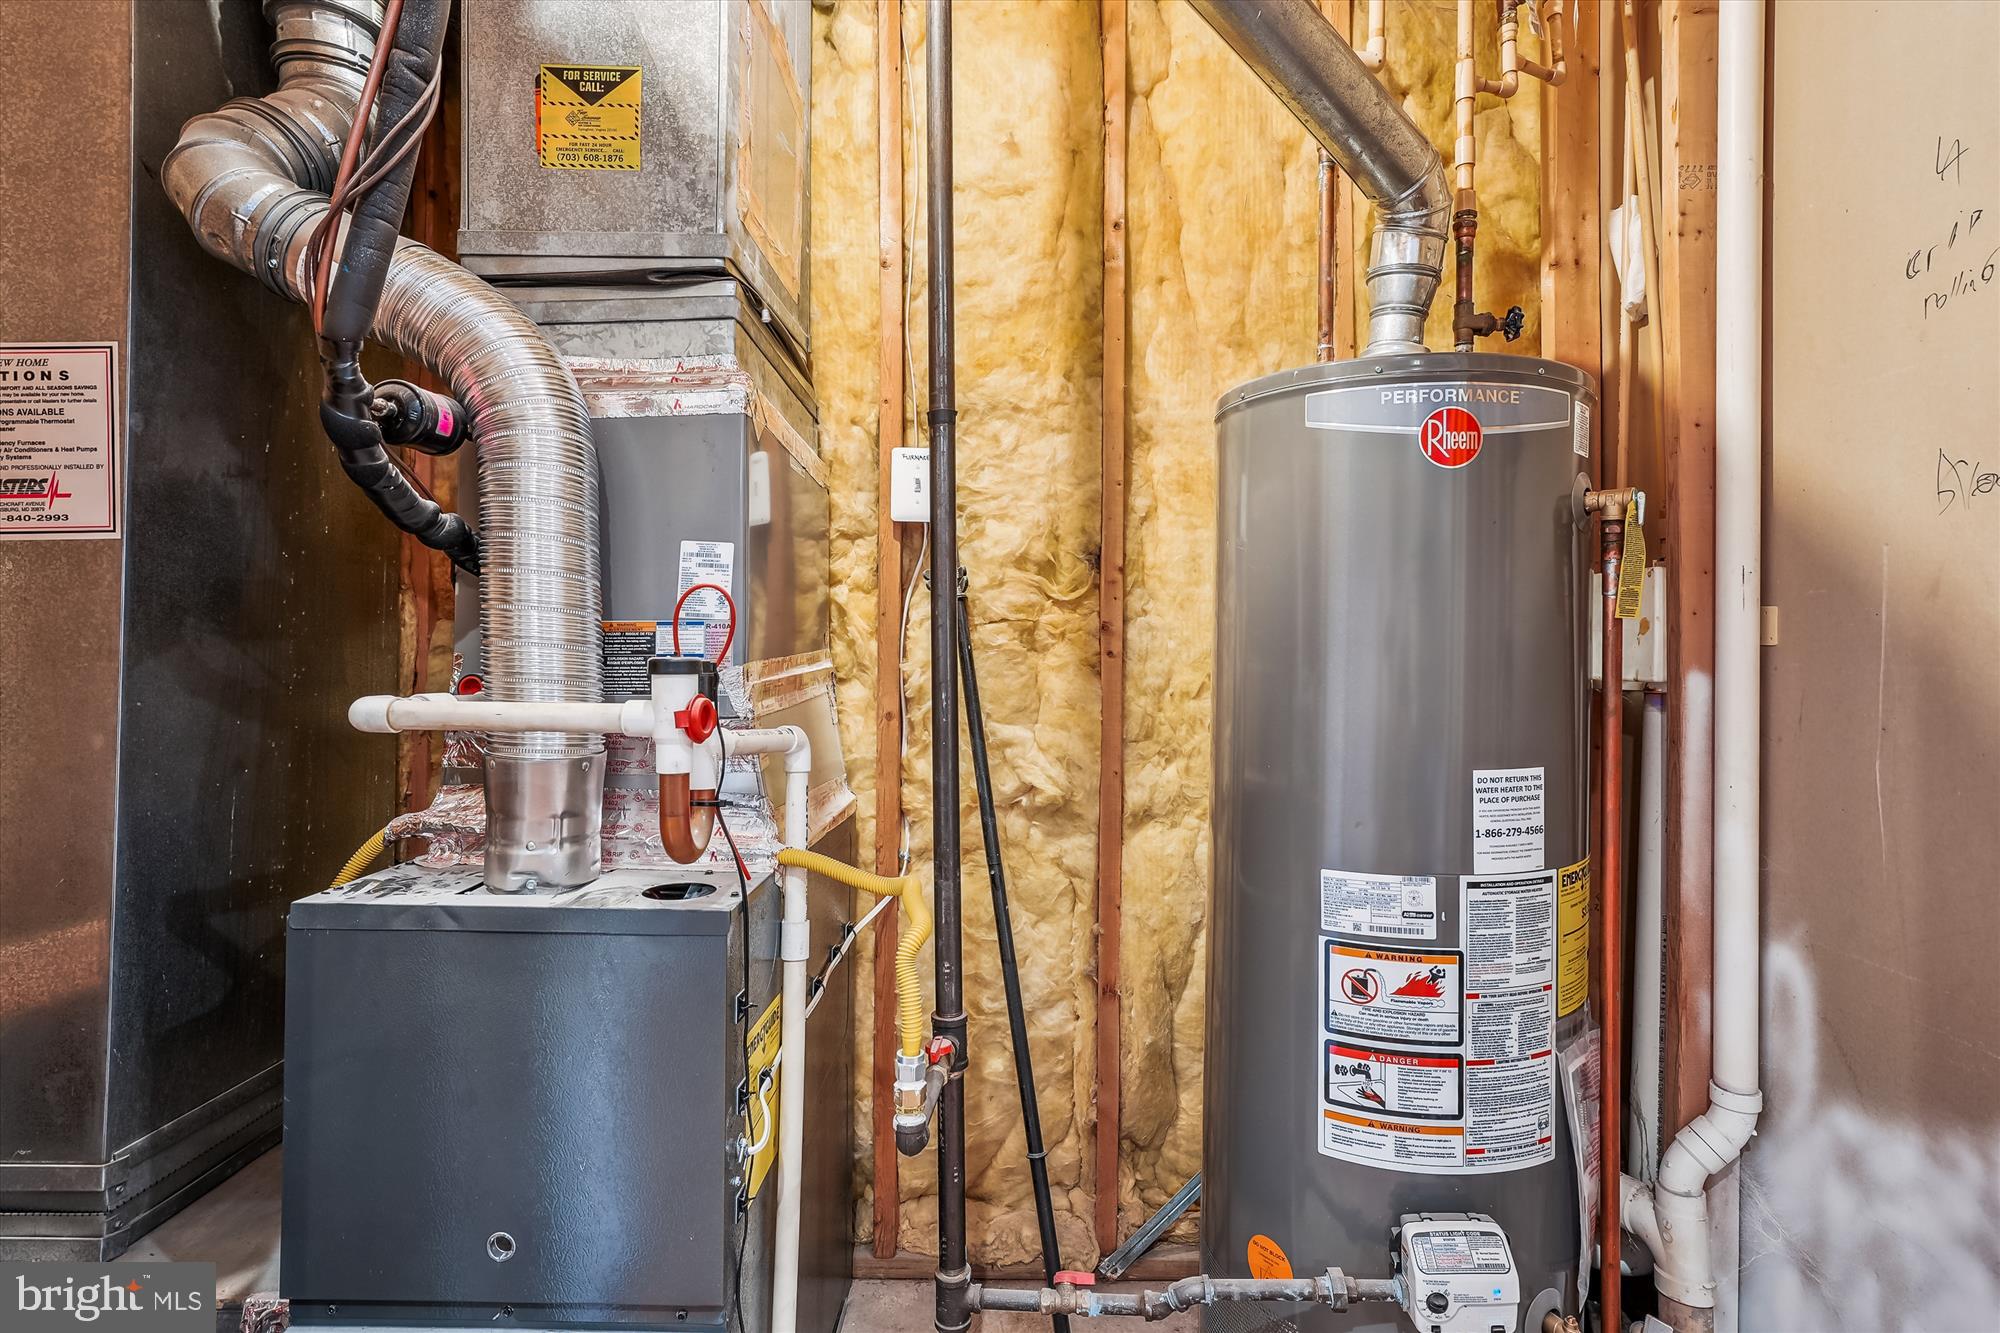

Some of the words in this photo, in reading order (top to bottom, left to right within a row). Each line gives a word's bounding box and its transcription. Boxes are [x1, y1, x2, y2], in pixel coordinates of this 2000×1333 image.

[563, 70, 580, 80] FOR
[583, 71, 621, 82] SERVICE
[580, 82, 605, 92] CALL:
[557, 153, 580, 162] (703)
[584, 154, 624, 162] 608-1876
[16, 358, 50, 367] HOME
[0, 370, 70, 381] TIONS
[1381, 388, 1520, 404] PERFORMANCE
[1427, 409, 1478, 458] Rheem
[1511, 794, 1540, 802] PURCHASE
[1476, 825, 1544, 838] 1-866-279-4566
[1376, 953, 1423, 962] WARNING
[1380, 1056, 1419, 1065] DANGER
[1380, 1123, 1420, 1133] WARNING
[1260, 1244, 1268, 1252] NOT
[1269, 1250, 1285, 1262] BLOCK
